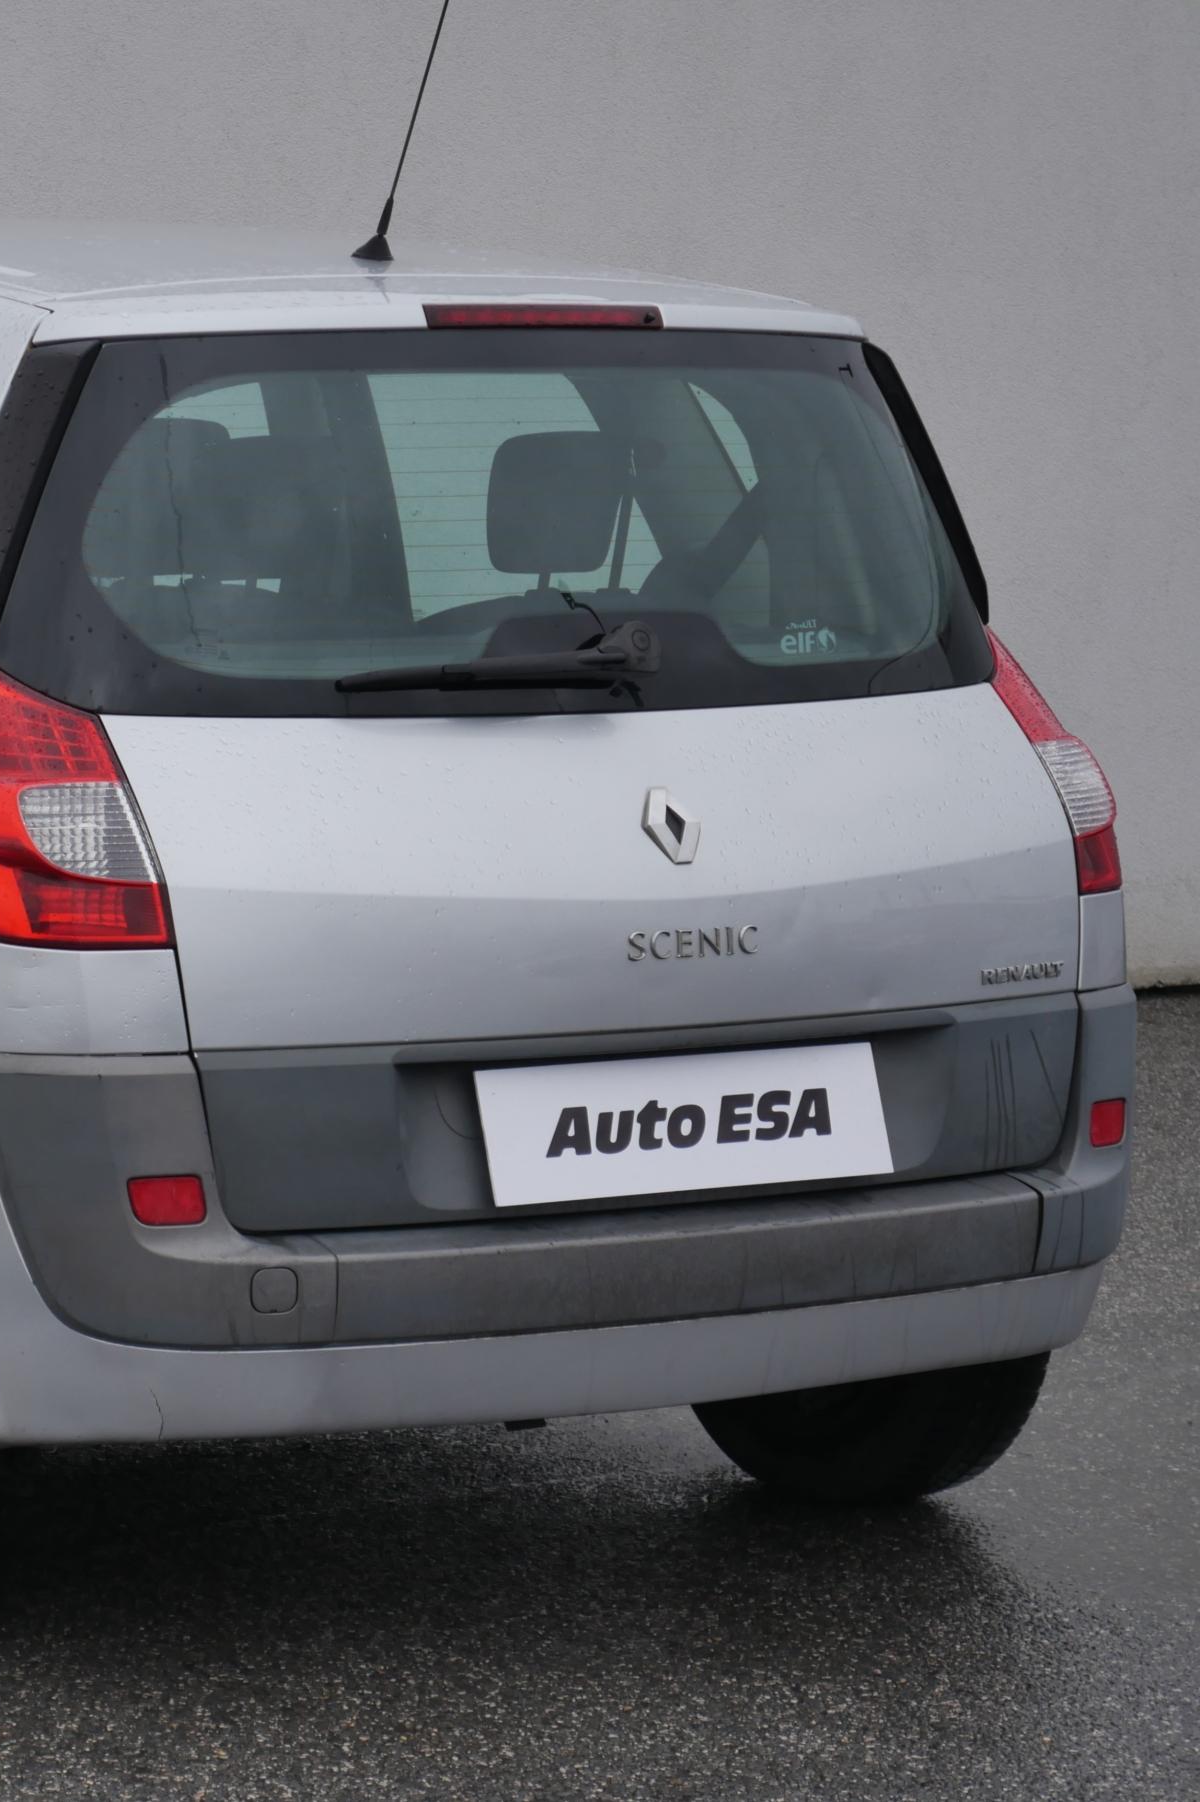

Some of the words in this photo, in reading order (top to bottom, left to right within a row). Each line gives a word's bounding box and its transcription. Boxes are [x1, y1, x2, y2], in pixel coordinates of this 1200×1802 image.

[780, 630, 815, 655] elf
[627, 924, 759, 961] SCENIC
[980, 960, 1064, 986] RENAULT
[546, 1100, 706, 1158] Auto
[716, 1087, 832, 1145] ESA
